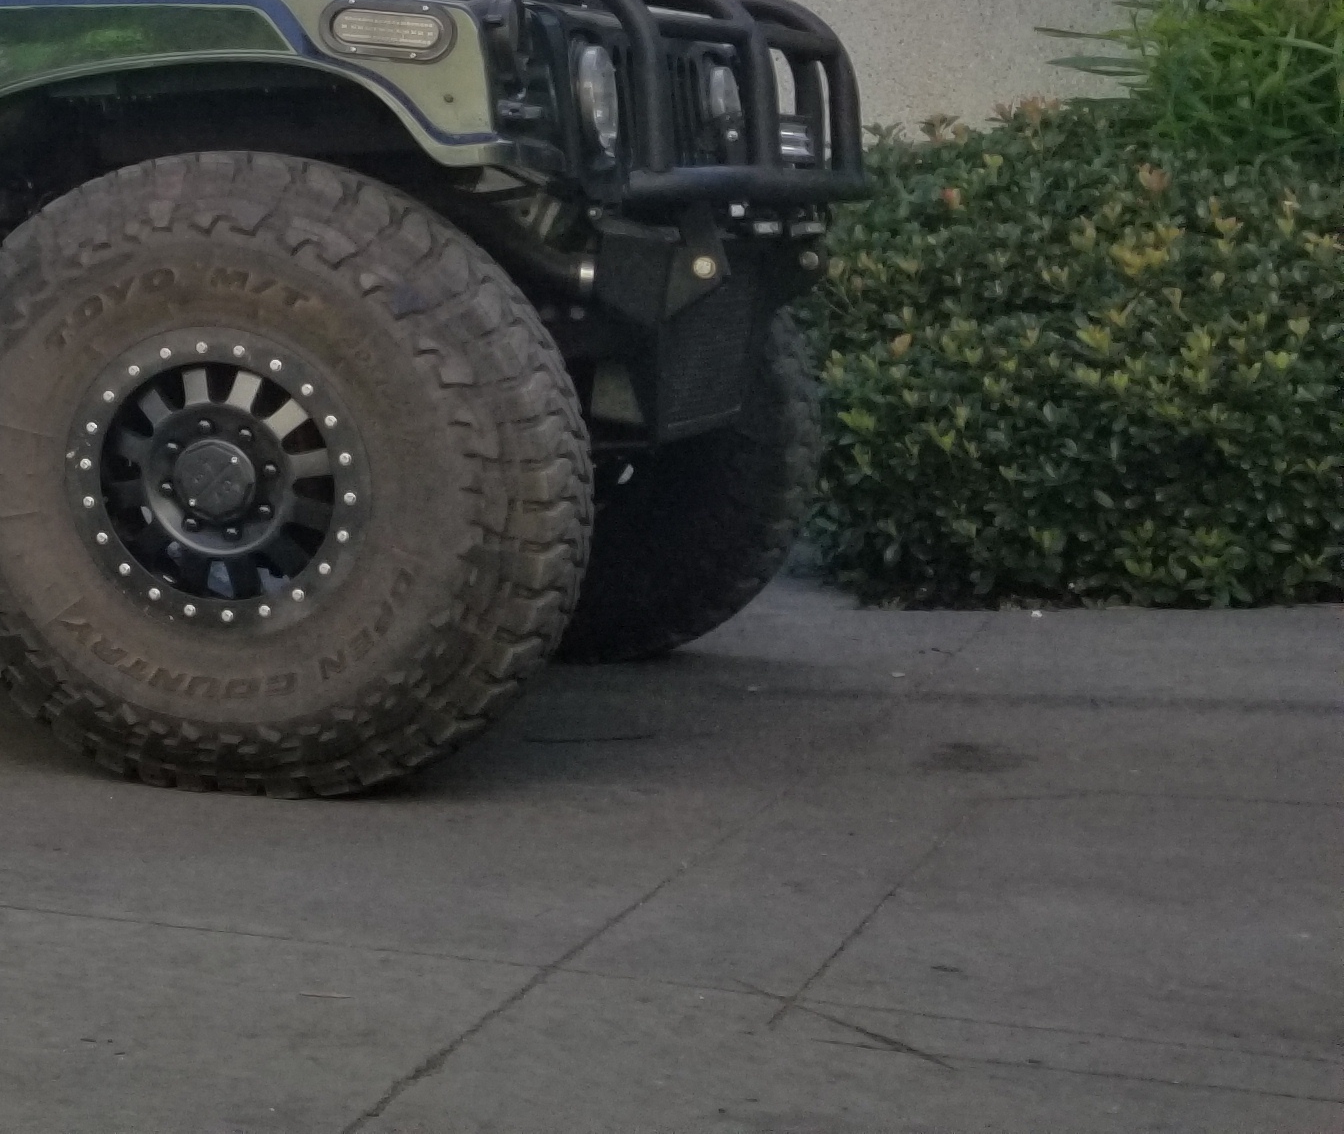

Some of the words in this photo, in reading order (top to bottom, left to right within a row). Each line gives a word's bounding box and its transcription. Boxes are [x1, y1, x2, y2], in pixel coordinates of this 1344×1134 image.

[44, 267, 175, 349] TOYO
[210, 267, 310, 307] M/T
[58, 619, 298, 699] COUNTRY
